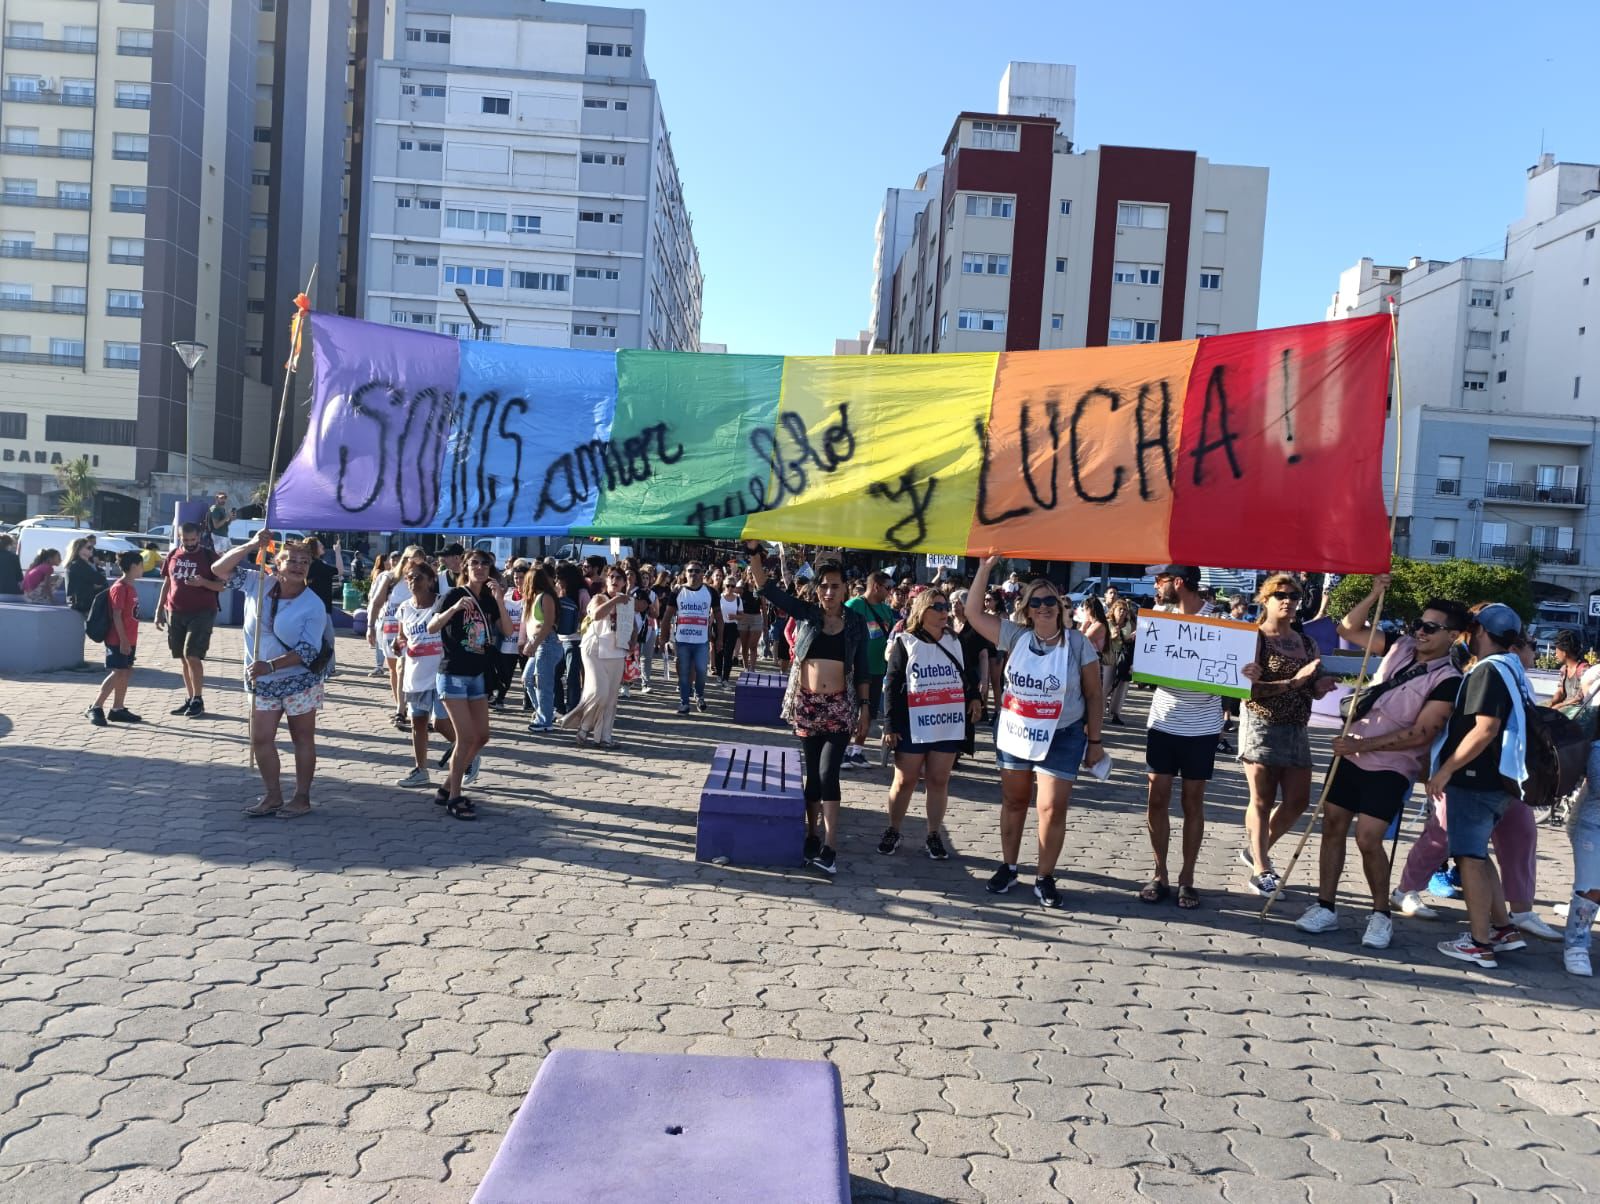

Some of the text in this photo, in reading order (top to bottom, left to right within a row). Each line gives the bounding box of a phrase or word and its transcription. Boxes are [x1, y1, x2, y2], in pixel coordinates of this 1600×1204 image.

[534, 420, 683, 522] amor
[686, 401, 856, 537] pueblo
[866, 465, 938, 549] y
[974, 364, 1243, 525] LUCHA
[1146, 621, 1160, 641] A
[1143, 643, 1158, 654] LE
[911, 662, 952, 679] Suteba
[917, 711, 965, 727] NECOCHEA
